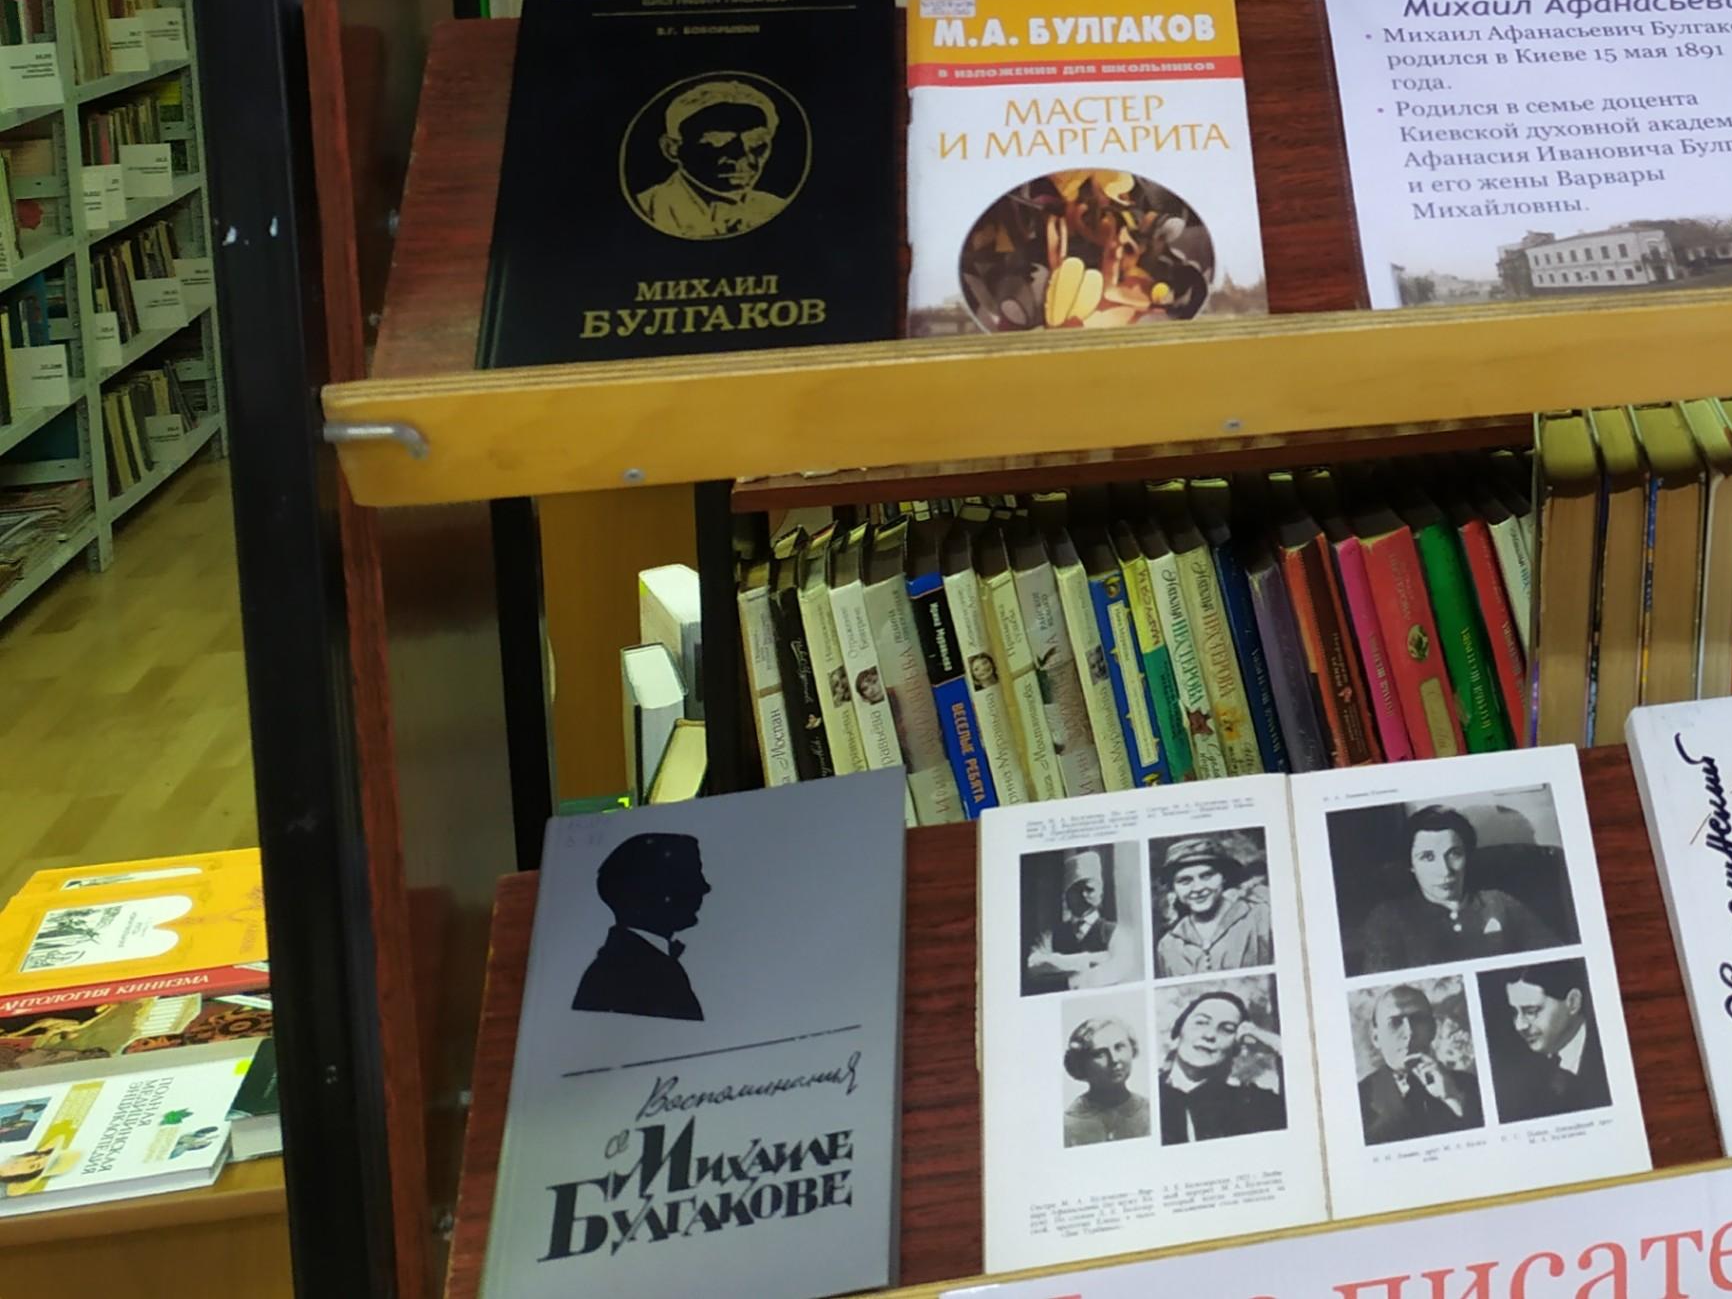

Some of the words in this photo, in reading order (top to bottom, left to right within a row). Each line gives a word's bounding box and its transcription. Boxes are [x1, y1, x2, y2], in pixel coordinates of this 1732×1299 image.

[933, 18, 1019, 48] М.А.
[1028, 14, 1216, 45] БУЛГАКОВ
[1383, 27, 1482, 43] Михаил
[1487, 22, 1645, 43] Афанасьевич
[1386, 53, 1489, 71] родился
[1496, 54, 1508, 65] в
[1515, 48, 1587, 65] Киеве
[1594, 47, 1618, 64] 15
[1624, 46, 1668, 59] мая
[1675, 43, 1724, 59] 1891
[1391, 77, 1452, 93] года.
[1004, 95, 1165, 127] МАСТЕР
[1395, 101, 1499, 118] Родился
[1507, 102, 1519, 114] в
[1526, 98, 1595, 114] семье
[1602, 92, 1699, 112] доцента
[939, 132, 968, 160] И
[984, 123, 1231, 160] МАРГАРИТА
[1399, 123, 1519, 143] Киевской
[1525, 117, 1640, 141] духовной
[1403, 149, 1531, 171] Афанасия
[1537, 143, 1674, 164] Ивановича
[1408, 181, 1423, 194] и
[1430, 179, 1471, 193] его
[1478, 175, 1549, 191] жены
[1556, 167, 1666, 189] Варвары
[1412, 199, 1591, 221] Михайловны.
[636, 275, 780, 303] МИХАИЛ
[579, 297, 827, 340] БУЛГАКОВ
[1171, 619, 1206, 707] НЕСТЕРОВА
[1202, 611, 1238, 699] НЕСТЕРОВА
[964, 758, 987, 805] РЕБЯТА
[635, 1051, 862, 1123] Воспоминания
[537, 1170, 854, 1263] БУЛГАКОВЕ
